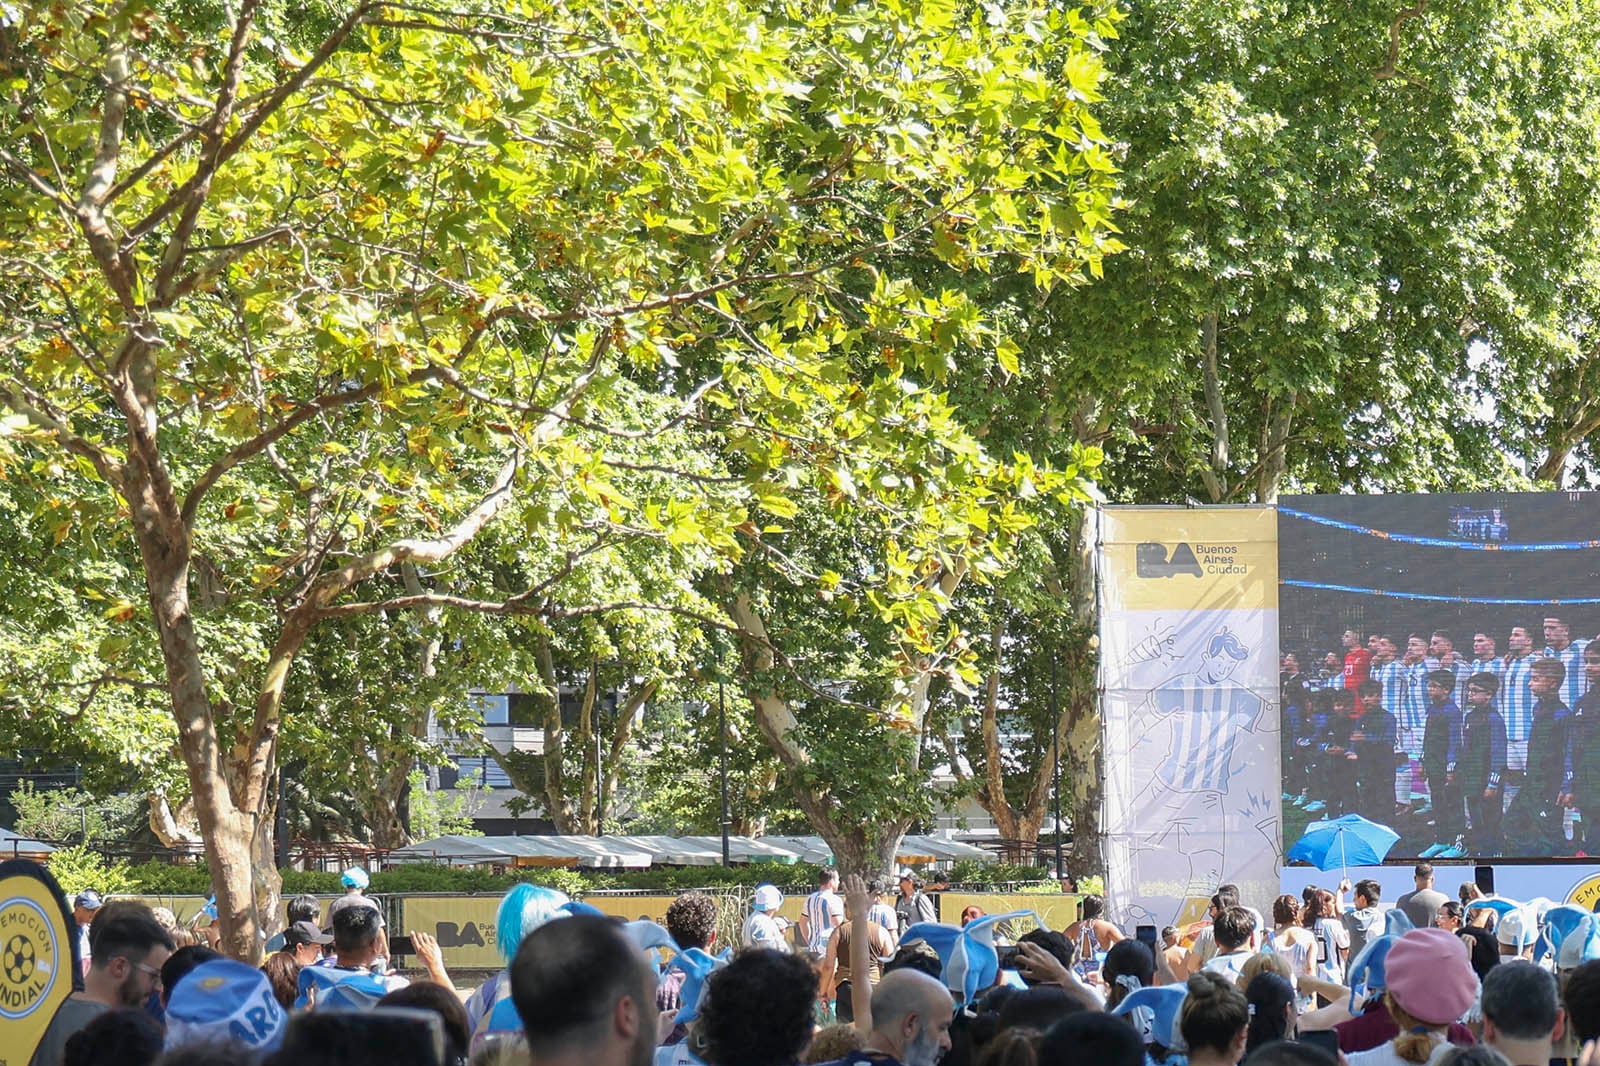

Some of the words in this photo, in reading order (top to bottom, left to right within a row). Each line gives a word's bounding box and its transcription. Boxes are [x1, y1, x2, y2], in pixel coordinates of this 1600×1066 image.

[1196, 545, 1237, 554] Buenos
[1136, 542, 1203, 578] BA
[1203, 555, 1234, 564] Aires
[1207, 564, 1247, 574] Ciudad
[1, 912, 52, 953] EMOCIÓN
[436, 922, 485, 947] BA
